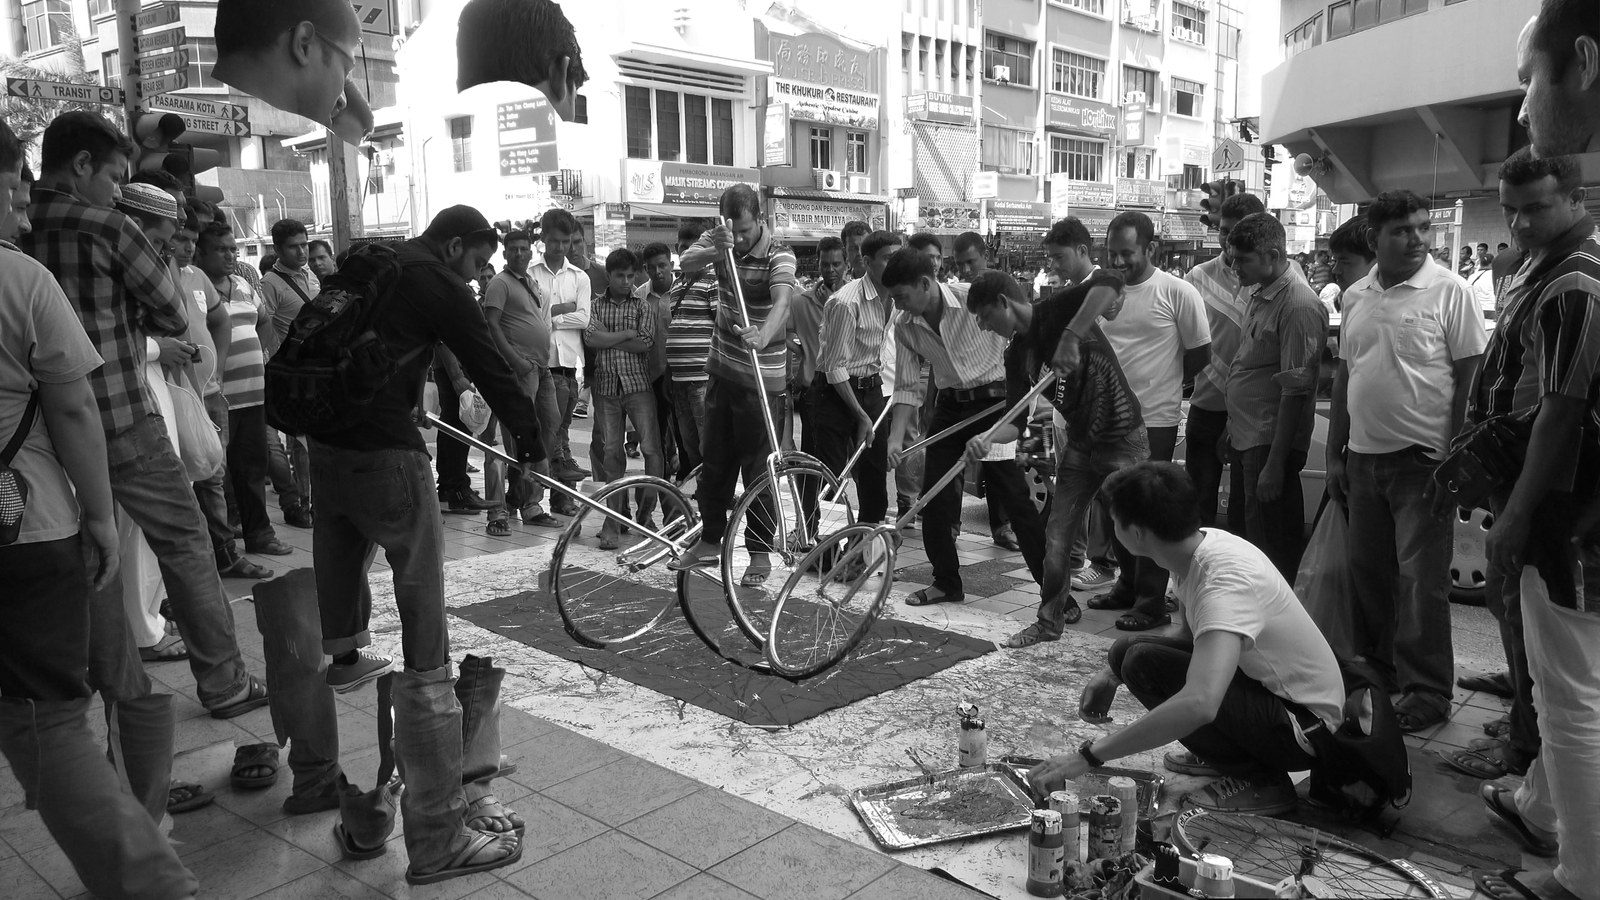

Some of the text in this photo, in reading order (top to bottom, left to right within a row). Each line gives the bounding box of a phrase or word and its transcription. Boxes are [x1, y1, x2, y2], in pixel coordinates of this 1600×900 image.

[52, 86, 92, 98] TRANSIT
[142, 81, 155, 93] PASAR
[776, 82, 878, 108] THE KHUKURI RESTAURANT
[928, 92, 952, 103] BUTIK
[155, 96, 216, 114] PASARAMA KOTA
[193, 119, 219, 131] STREET
[680, 168, 709, 177] PEMBORONG
[665, 176, 686, 188] MALIK
[686, 177, 716, 190] STREAMS
[776, 202, 810, 211] PEMBORONG
[810, 204, 823, 212] DAN
[792, 214, 813, 224] KABIR
[814, 214, 831, 227] MAJU
[831, 215, 846, 227] JAYA
[1435, 211, 1442, 219] AH
[1057, 378, 1066, 404] JUST
